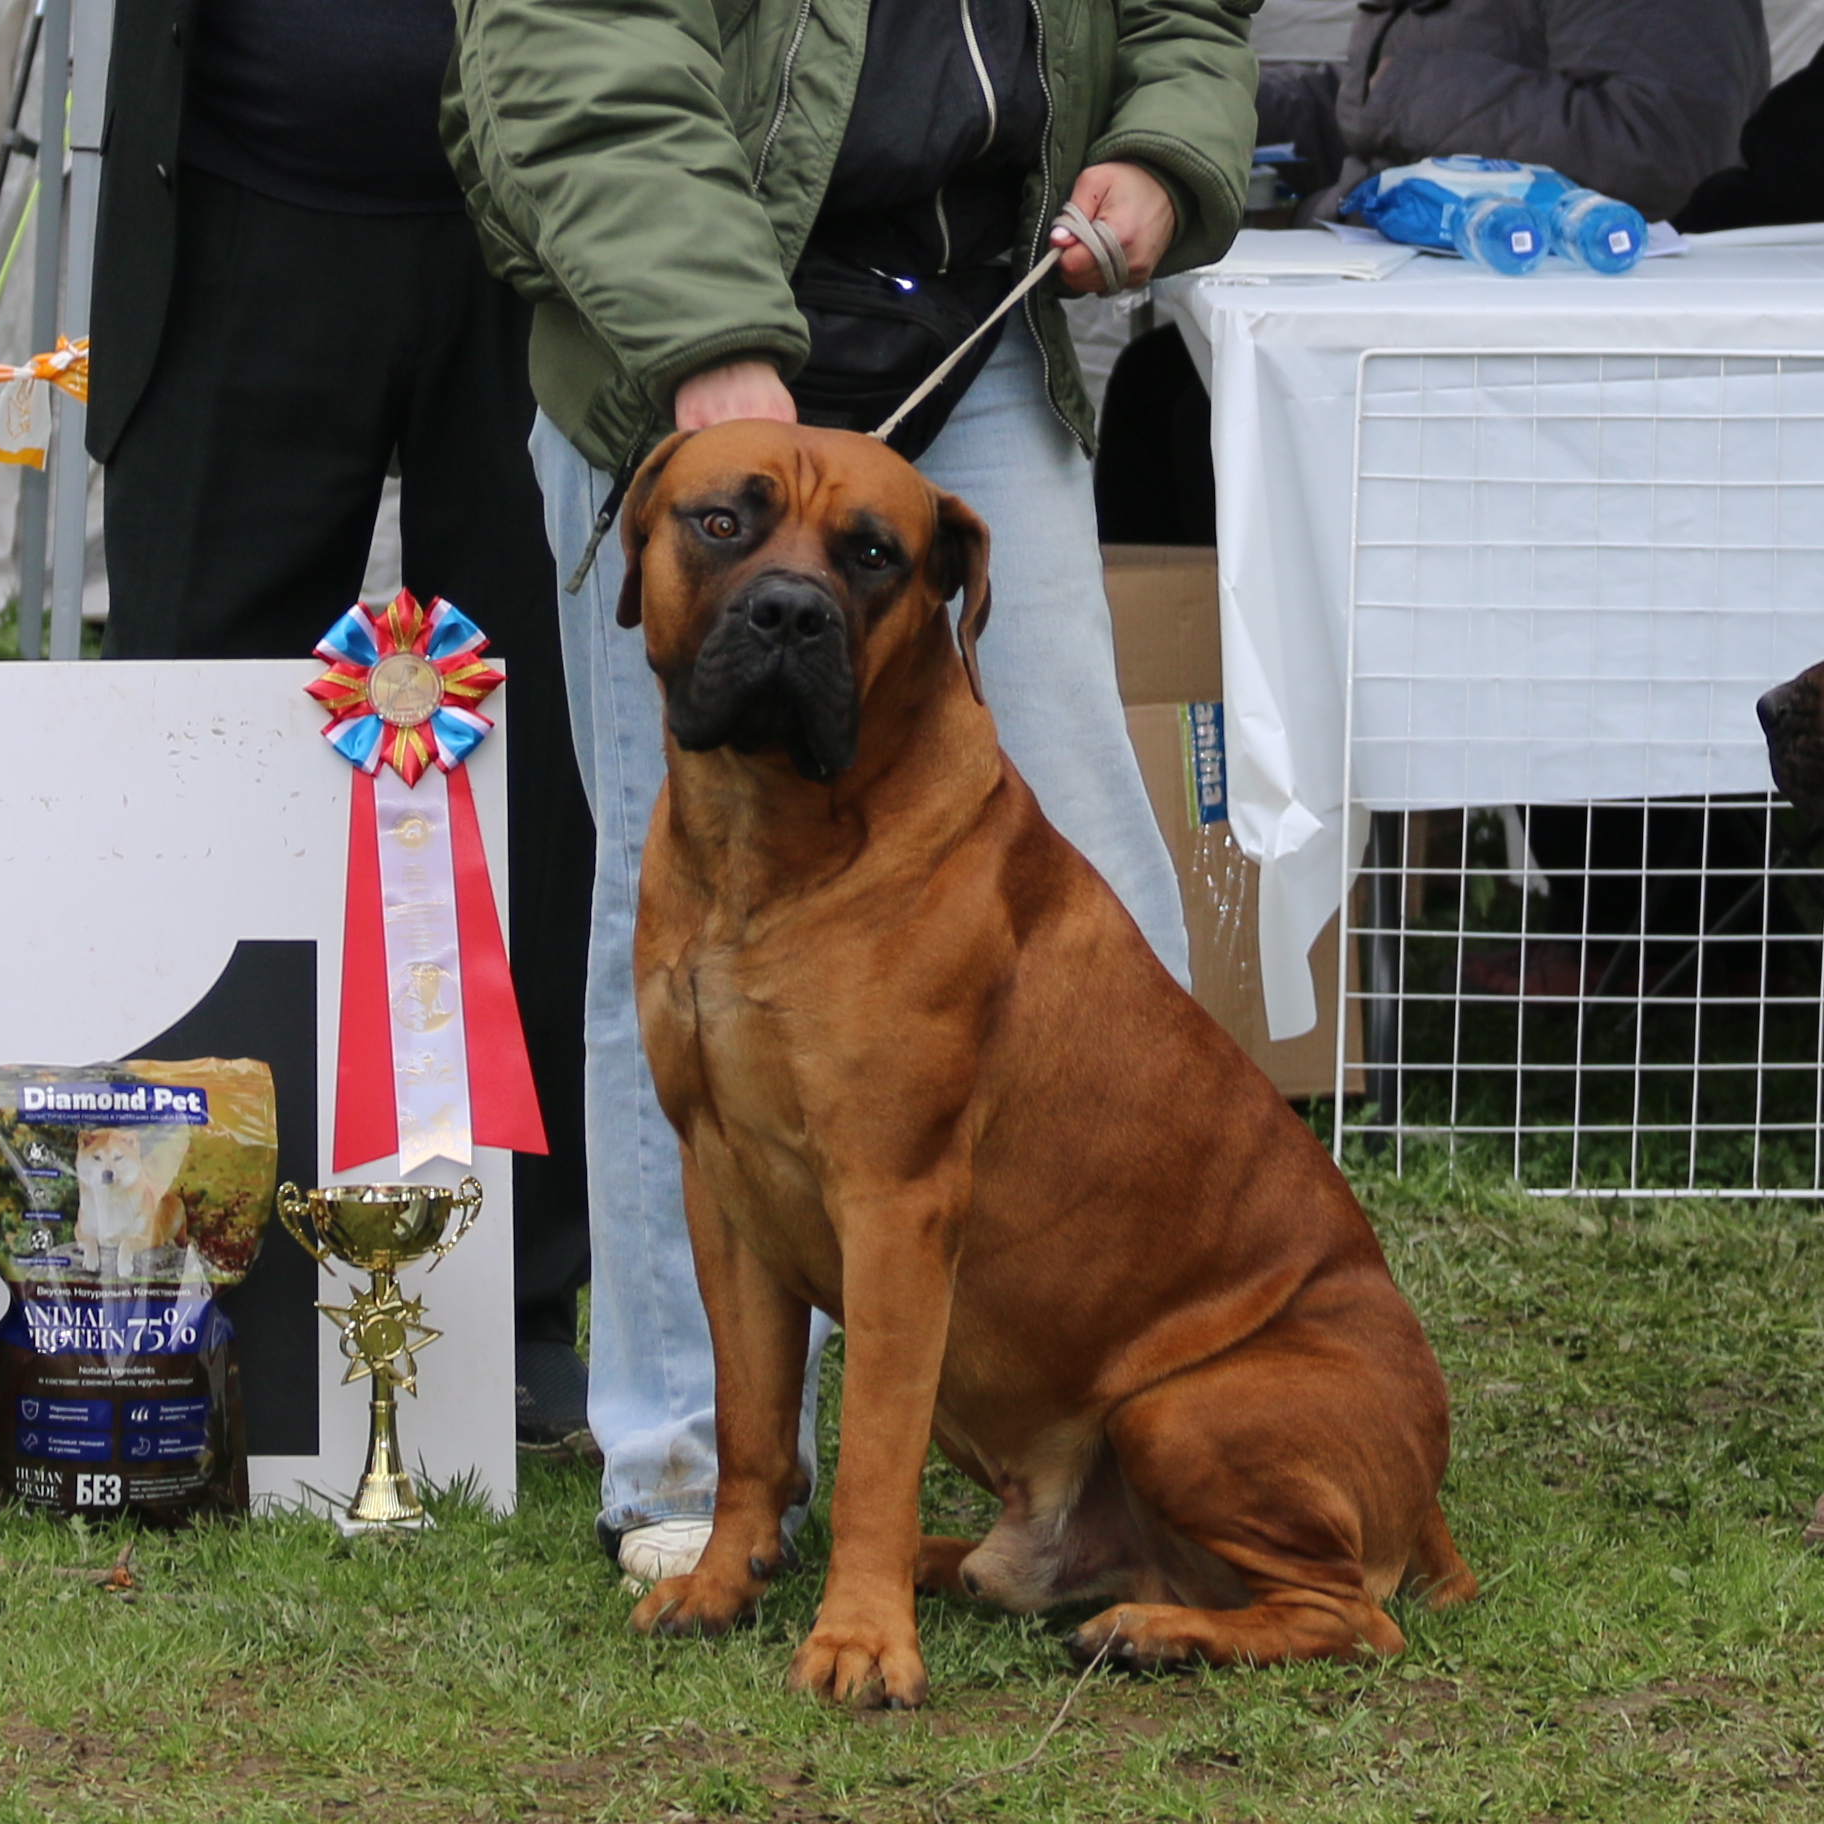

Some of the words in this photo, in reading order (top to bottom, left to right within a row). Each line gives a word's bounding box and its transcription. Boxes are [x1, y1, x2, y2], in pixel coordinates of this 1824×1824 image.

[24, 1086, 147, 1112] Diamond
[153, 1087, 202, 1114] Pet
[118, 939, 318, 1456] 1
[25, 1306, 112, 1328] ANIMAL
[128, 1304, 197, 1352] 75%
[79, 1366, 108, 1375] Natural
[16, 1466, 63, 1485] HUMAN
[16, 1481, 59, 1499] GRADE
[77, 1474, 122, 1506] БЕЗ
